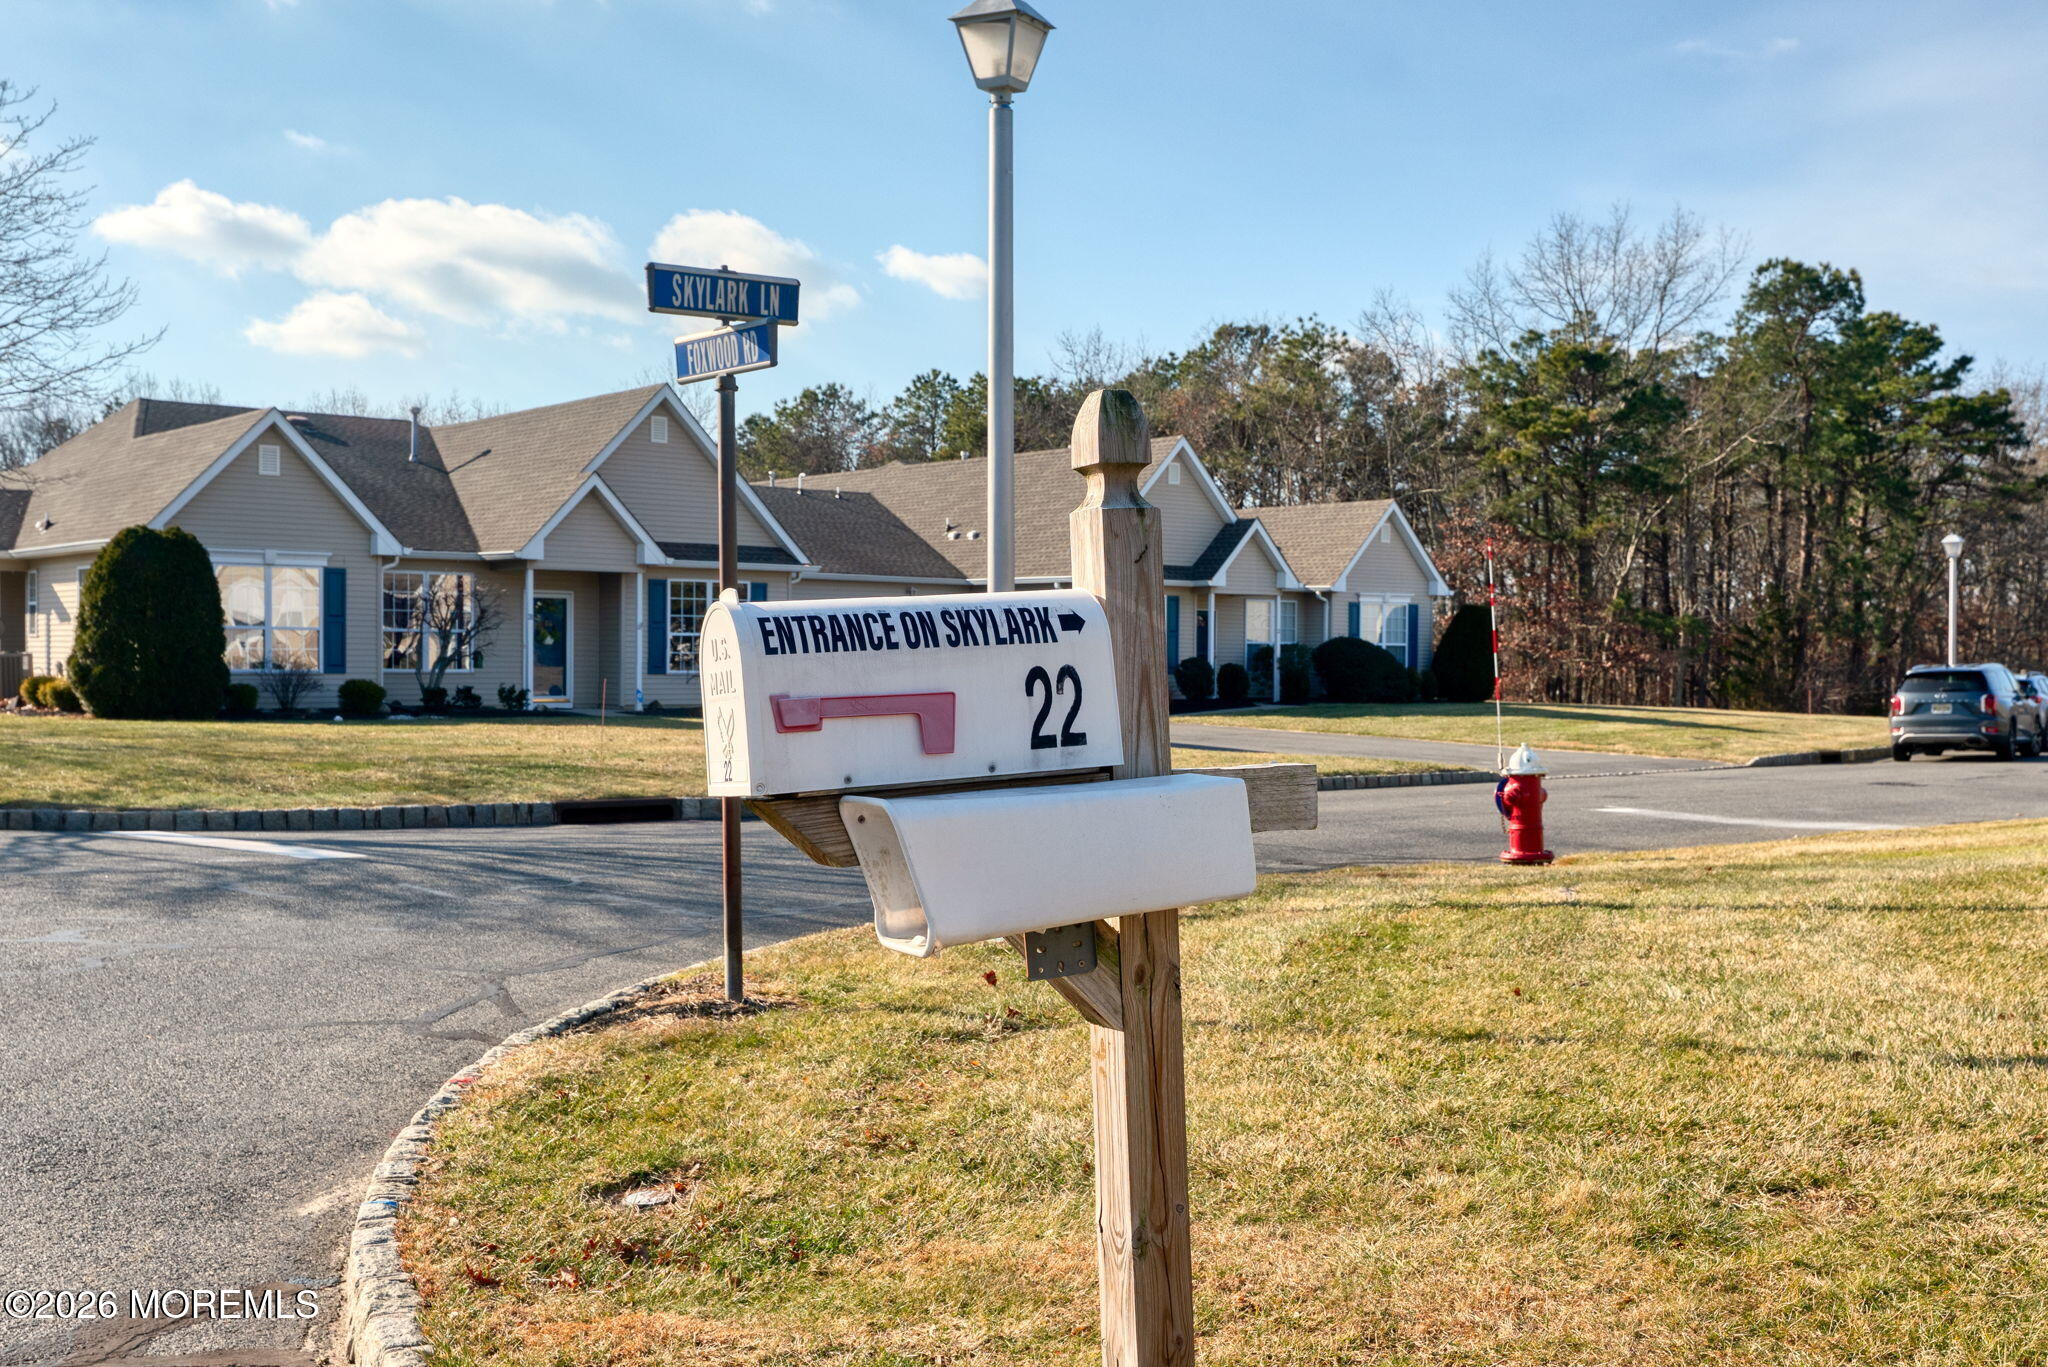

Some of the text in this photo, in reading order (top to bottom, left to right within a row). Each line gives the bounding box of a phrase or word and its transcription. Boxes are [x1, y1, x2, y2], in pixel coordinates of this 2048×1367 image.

[672, 273, 780, 316] SKYLARK LN
[687, 330, 759, 375] FOXWOOD RD
[711, 637, 731, 662] U.S.
[757, 606, 1058, 656] ENTRANCE ON SKYLARK
[710, 669, 737, 696] MAIL
[1025, 664, 1087, 750] 22
[723, 760, 733, 782] 22
